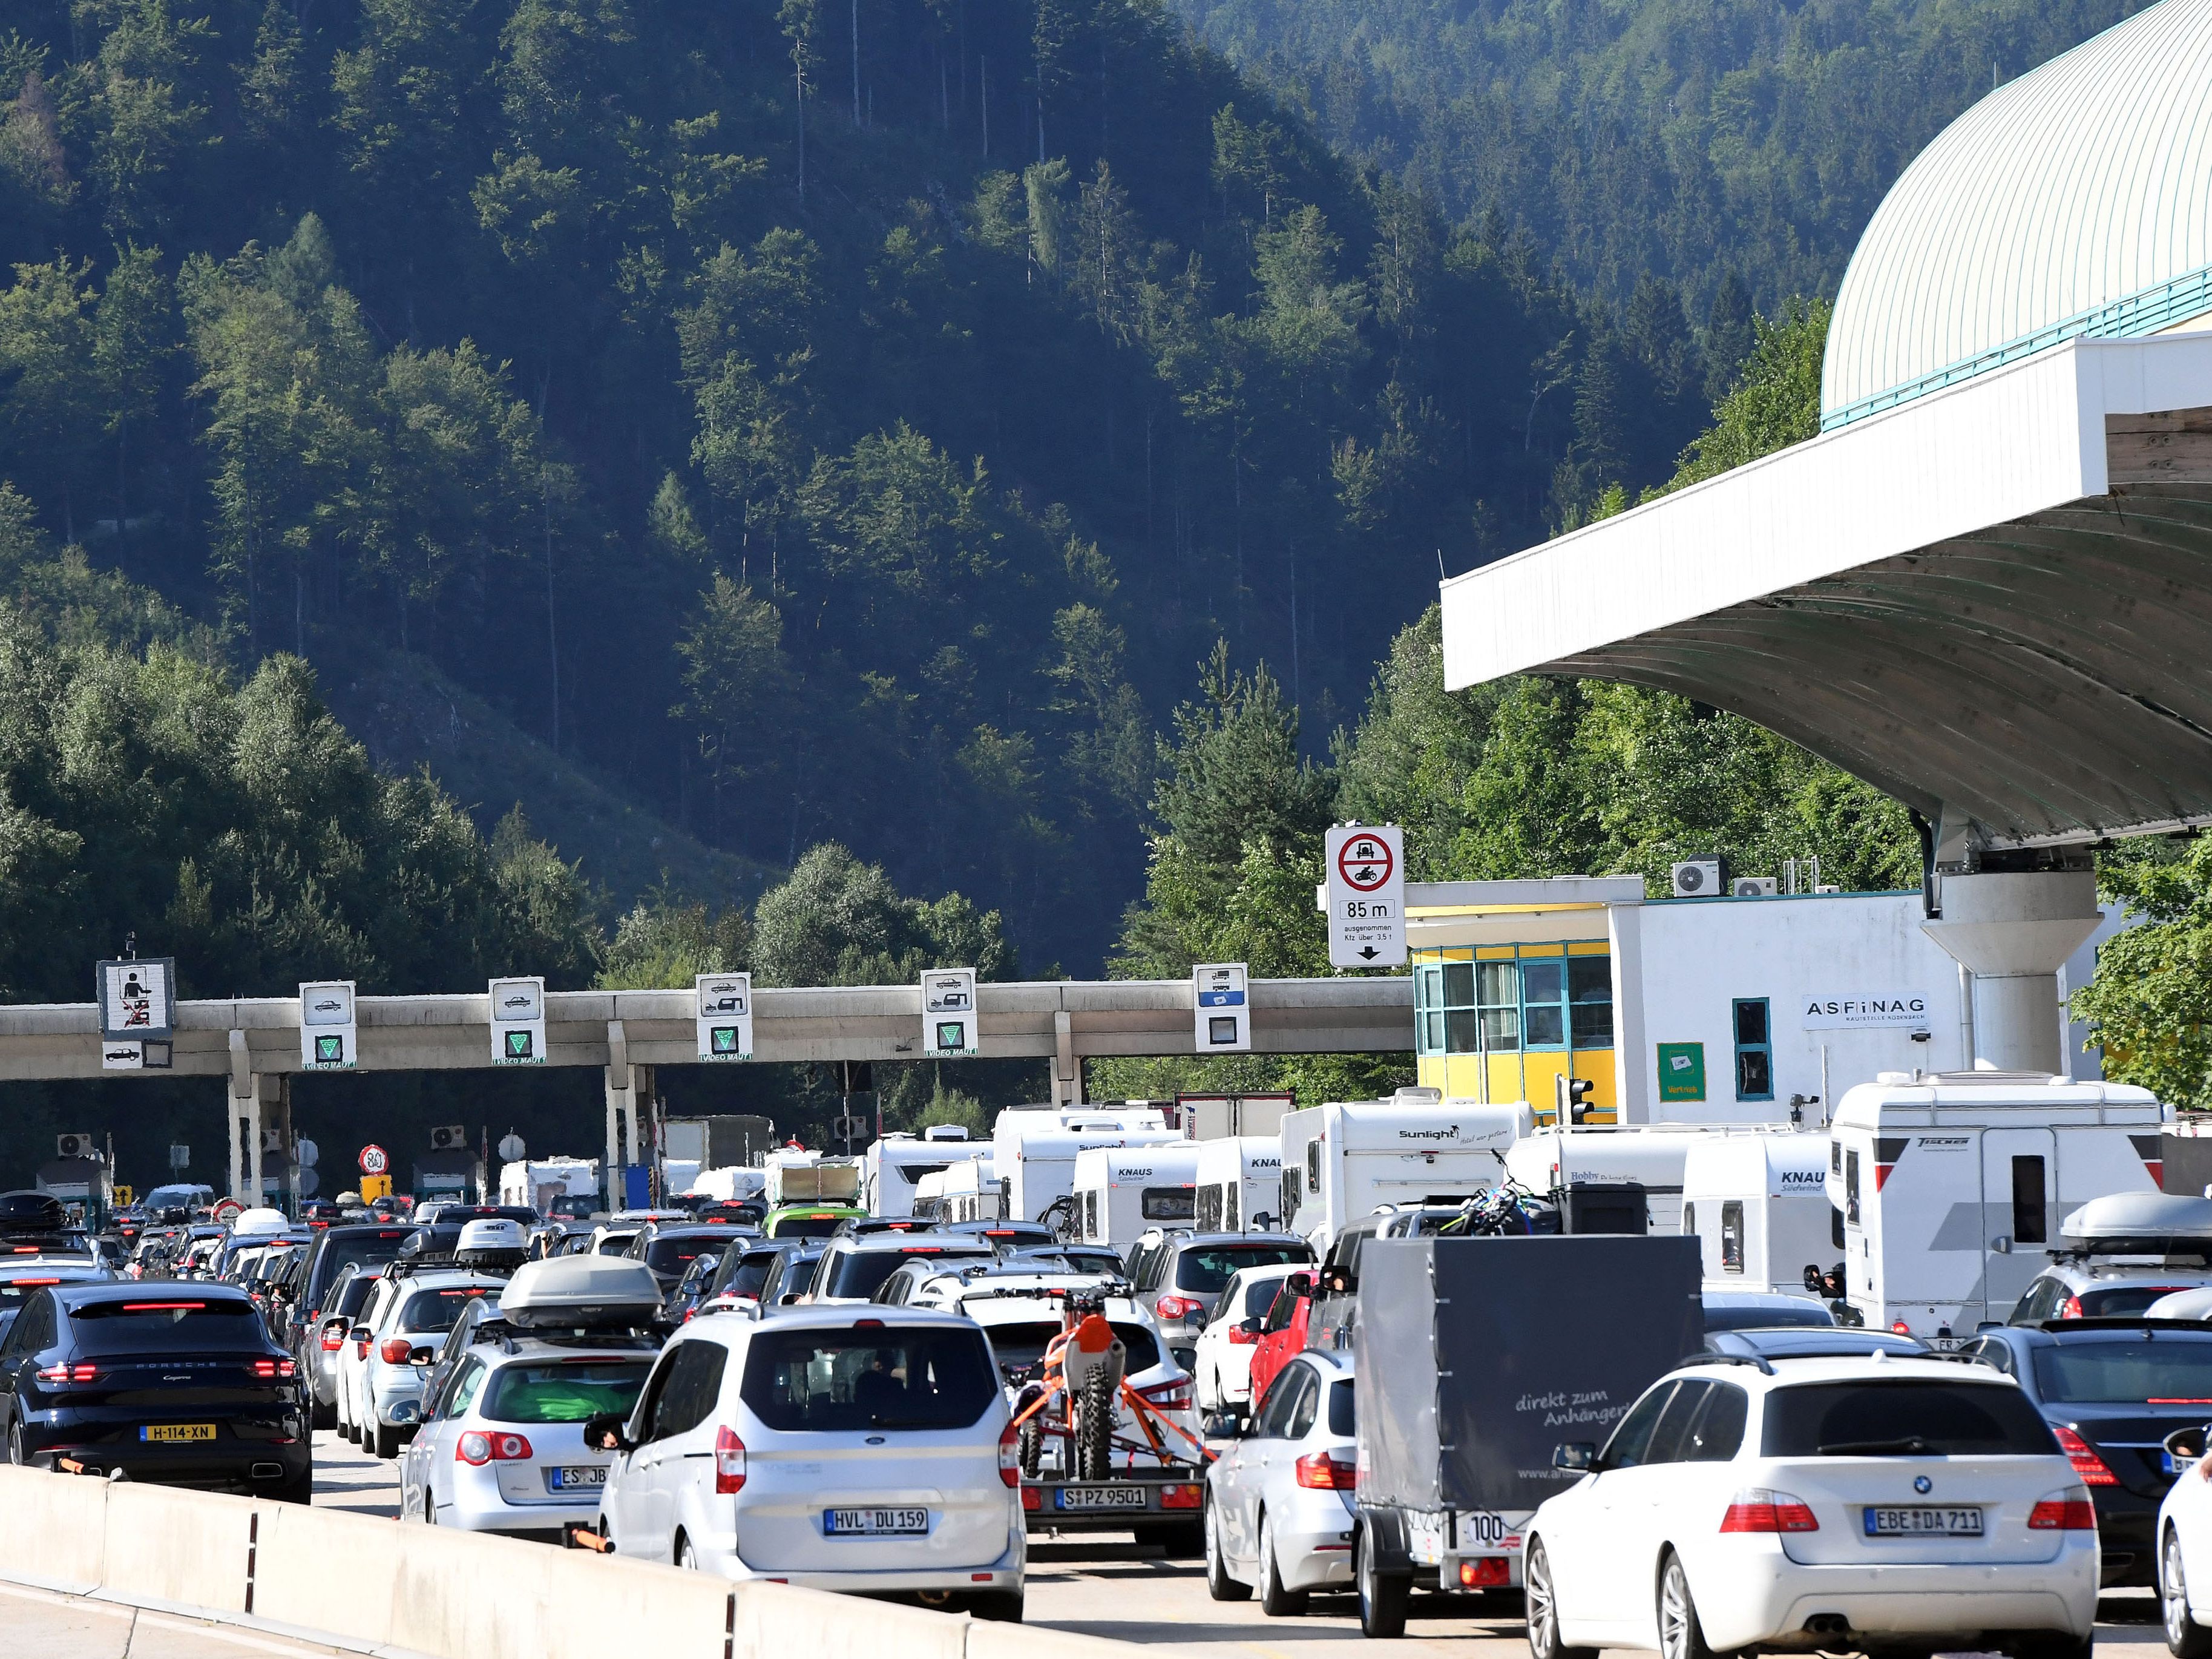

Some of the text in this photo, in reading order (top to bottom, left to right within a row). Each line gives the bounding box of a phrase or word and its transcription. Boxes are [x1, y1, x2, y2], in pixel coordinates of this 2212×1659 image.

[1348, 902, 1387, 918] 85 m
[1399, 1130, 1455, 1140] Sunlight
[1571, 1172, 1600, 1182] Hobby
[1782, 1172, 1825, 1183] KNAU
[1515, 1390, 1608, 1411] direkt zum
[154, 1426, 209, 1439] H-114-XN
[562, 1469, 607, 1483] ES JB
[1065, 1489, 1143, 1505] S PZ 9501
[836, 1511, 924, 1528] HVL DU 159
[1877, 1512, 1979, 1529] EBE DA 711
[1471, 1516, 1502, 1540] 100
